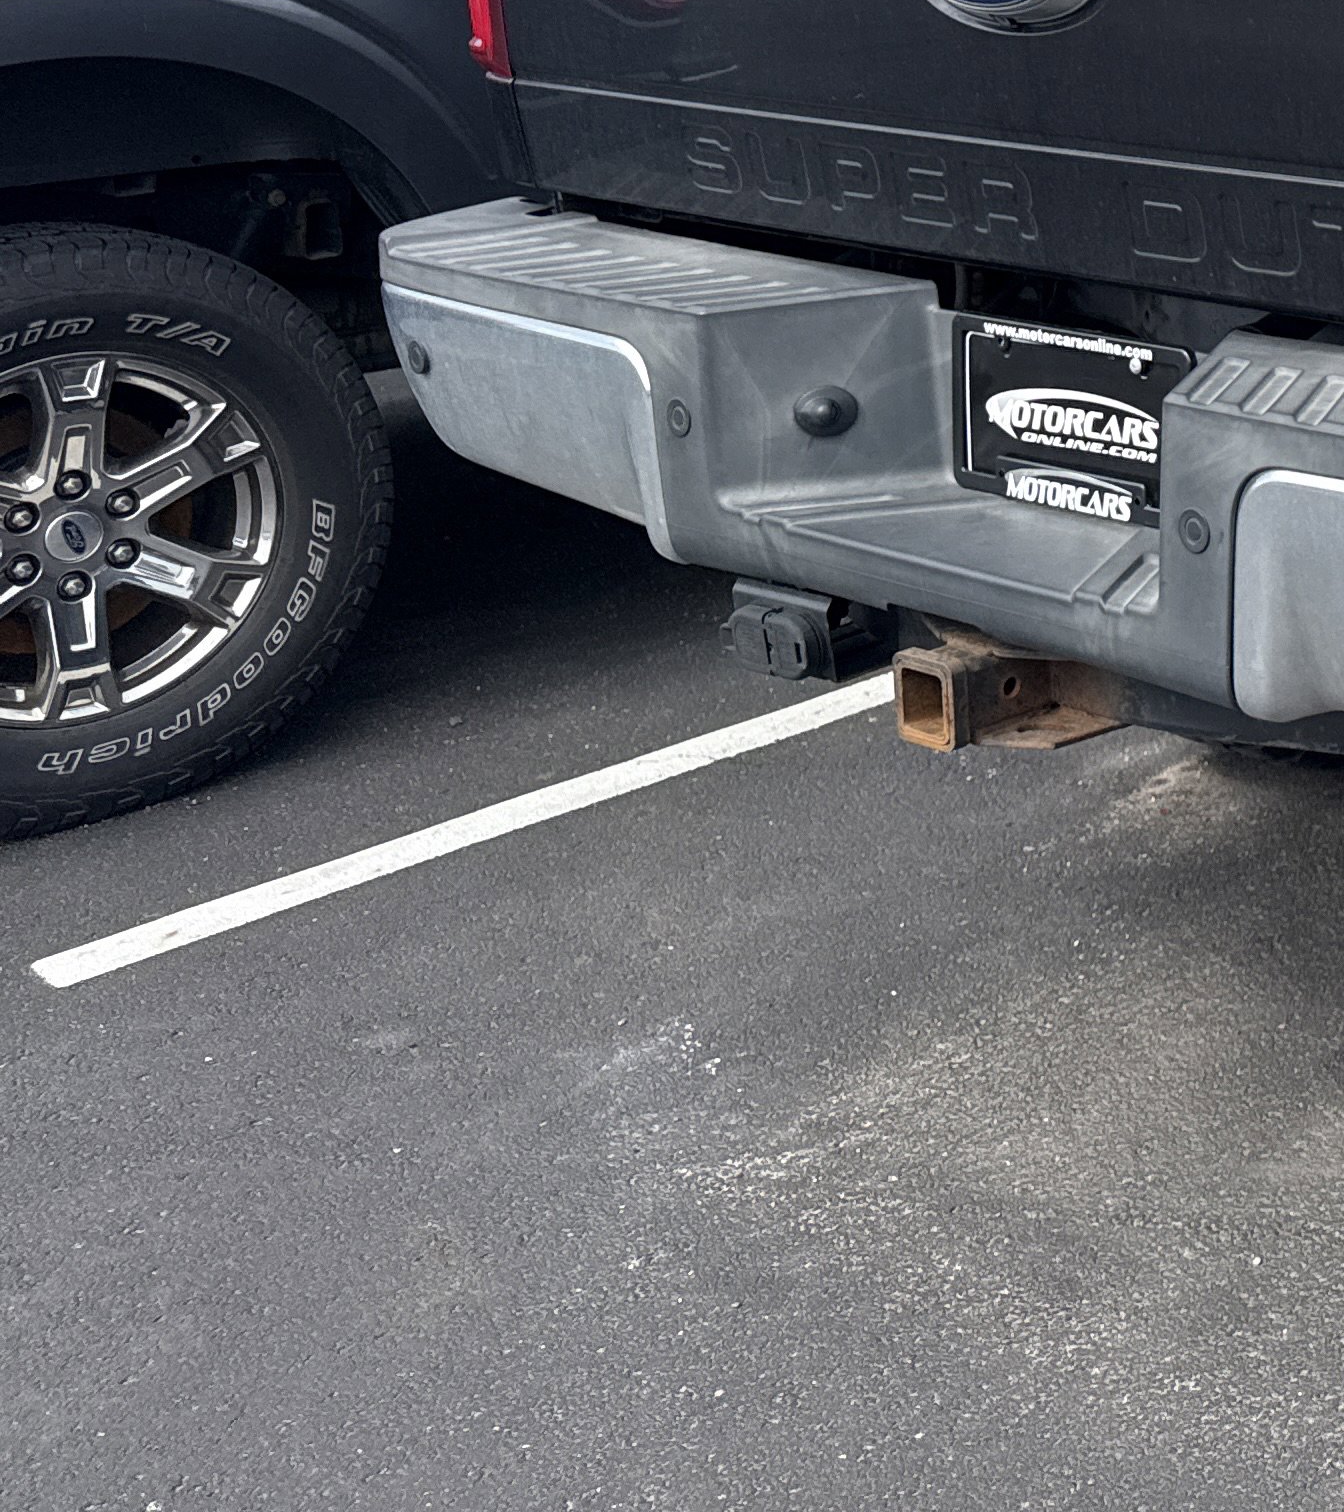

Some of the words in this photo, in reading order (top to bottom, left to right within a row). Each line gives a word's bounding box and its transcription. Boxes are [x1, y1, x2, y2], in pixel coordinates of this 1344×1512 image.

[681, 125, 1038, 241] SUPER
[125, 313, 232, 357] T/A
[983, 321, 1153, 361] www.motorcarsonline.com
[987, 397, 1160, 450] MOTORCARS
[1020, 431, 1158, 464] ONLINE.COM
[1005, 473, 1133, 523] MOTORCARS
[37, 499, 336, 775] BFGoodrich
